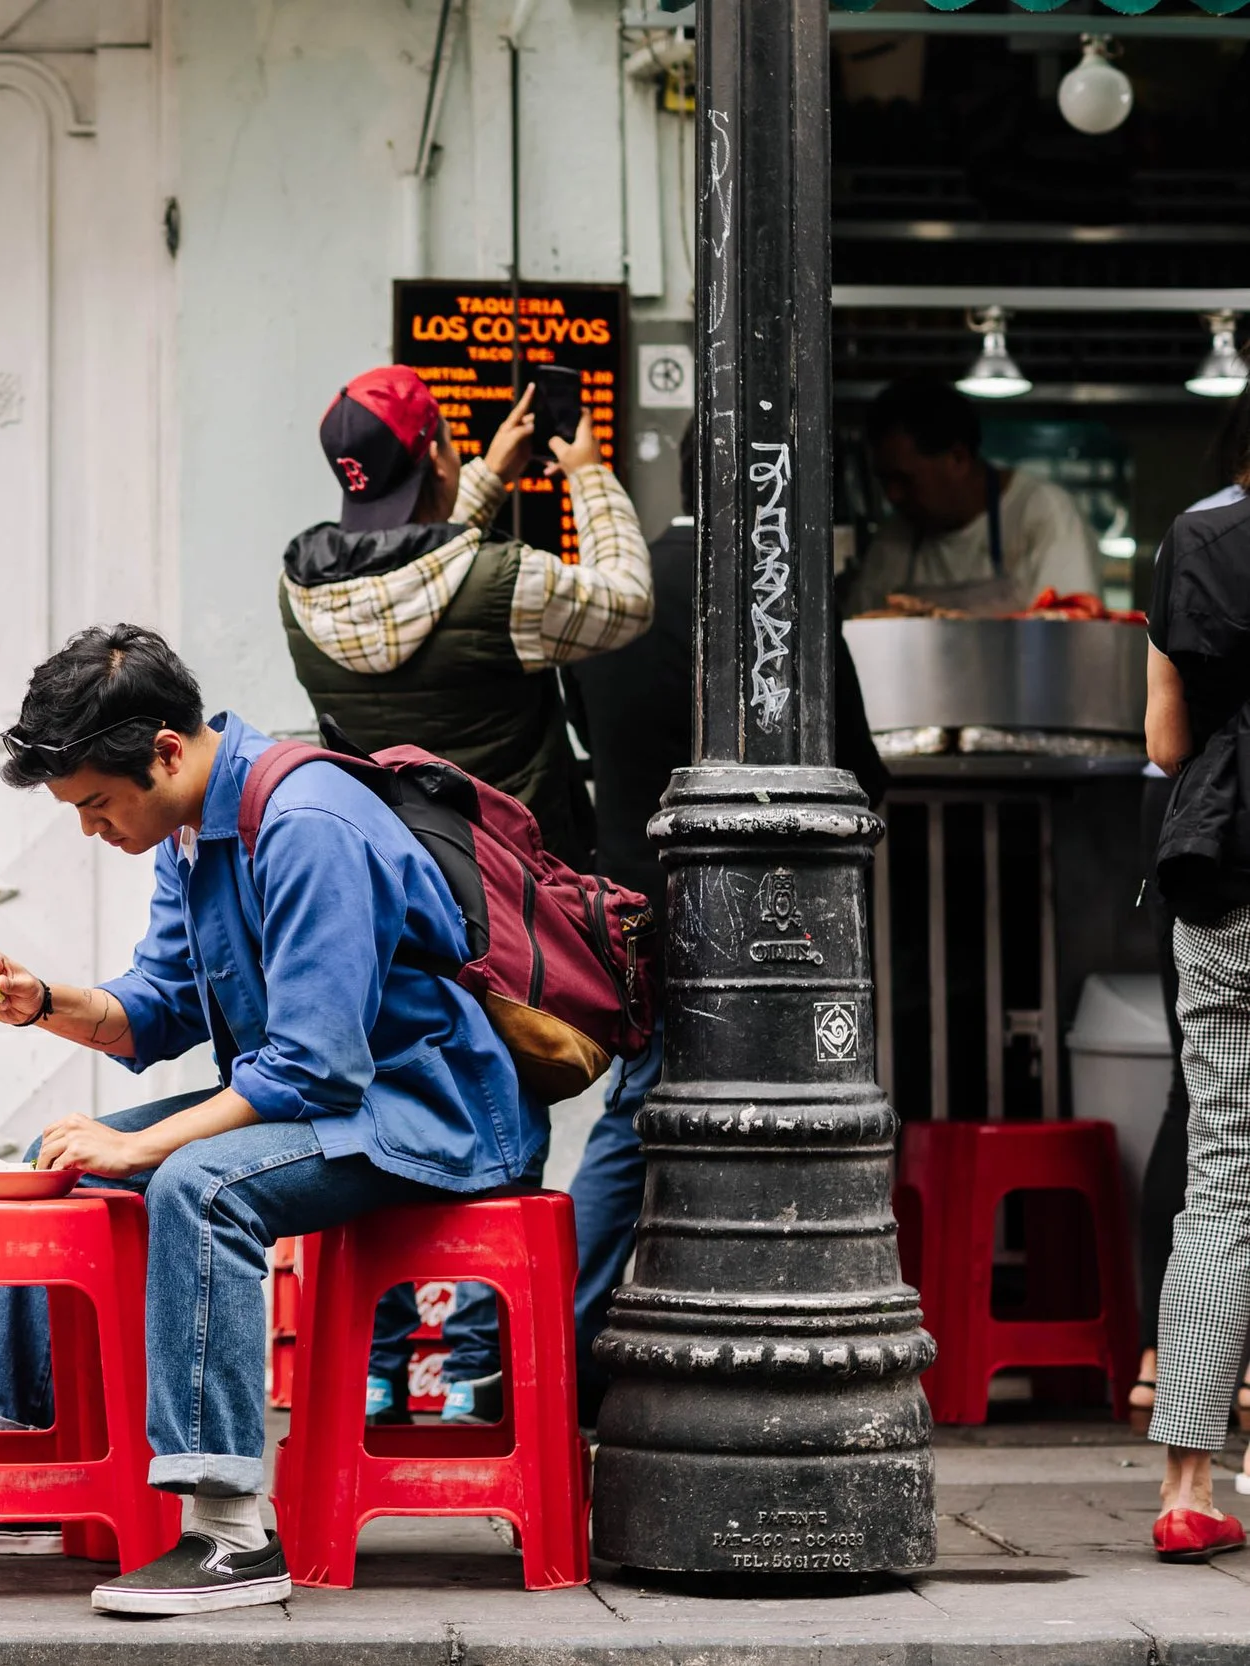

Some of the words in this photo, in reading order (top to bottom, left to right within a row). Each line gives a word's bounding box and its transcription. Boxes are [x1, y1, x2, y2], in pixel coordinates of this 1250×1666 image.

[456, 296, 566, 316] TAQUERIA
[412, 315, 469, 342] LOS
[471, 316, 611, 345] COCUYOS
[467, 346, 524, 362] TACO
[757, 1511, 828, 1526] PATENTE
